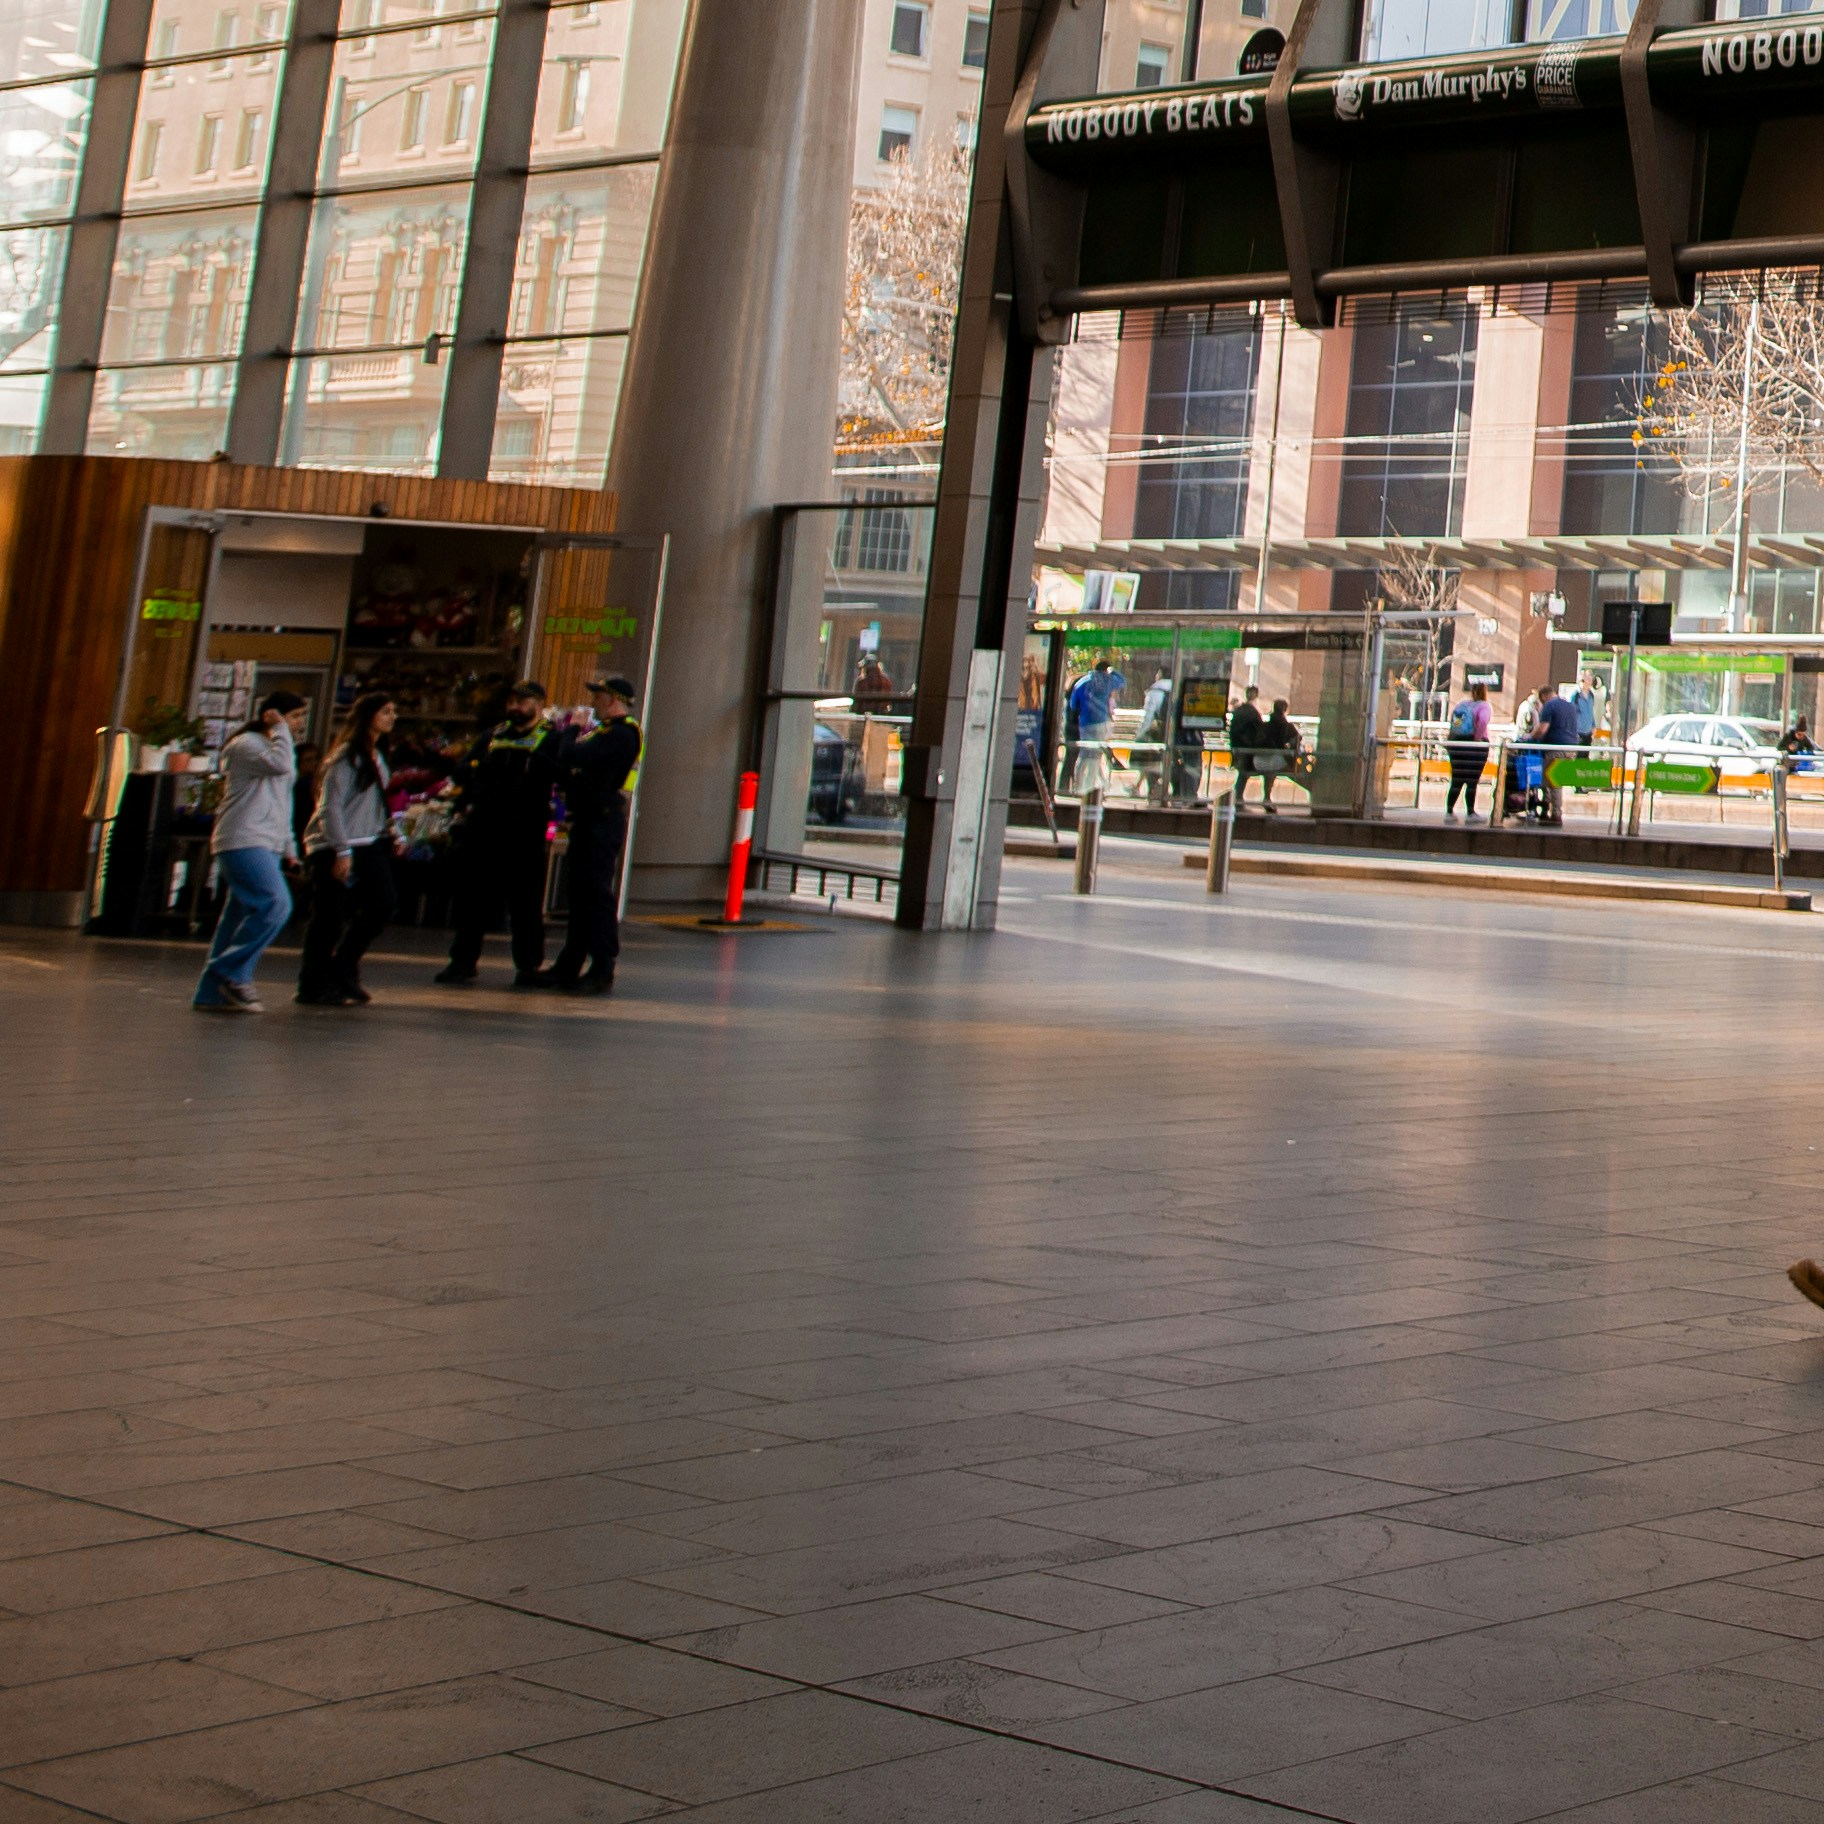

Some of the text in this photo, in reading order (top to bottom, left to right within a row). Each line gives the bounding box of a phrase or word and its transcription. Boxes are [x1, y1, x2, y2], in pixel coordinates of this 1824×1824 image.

[1536, 66, 1572, 85] PRICE
[1048, 91, 1255, 143] NOBODY BEATS
